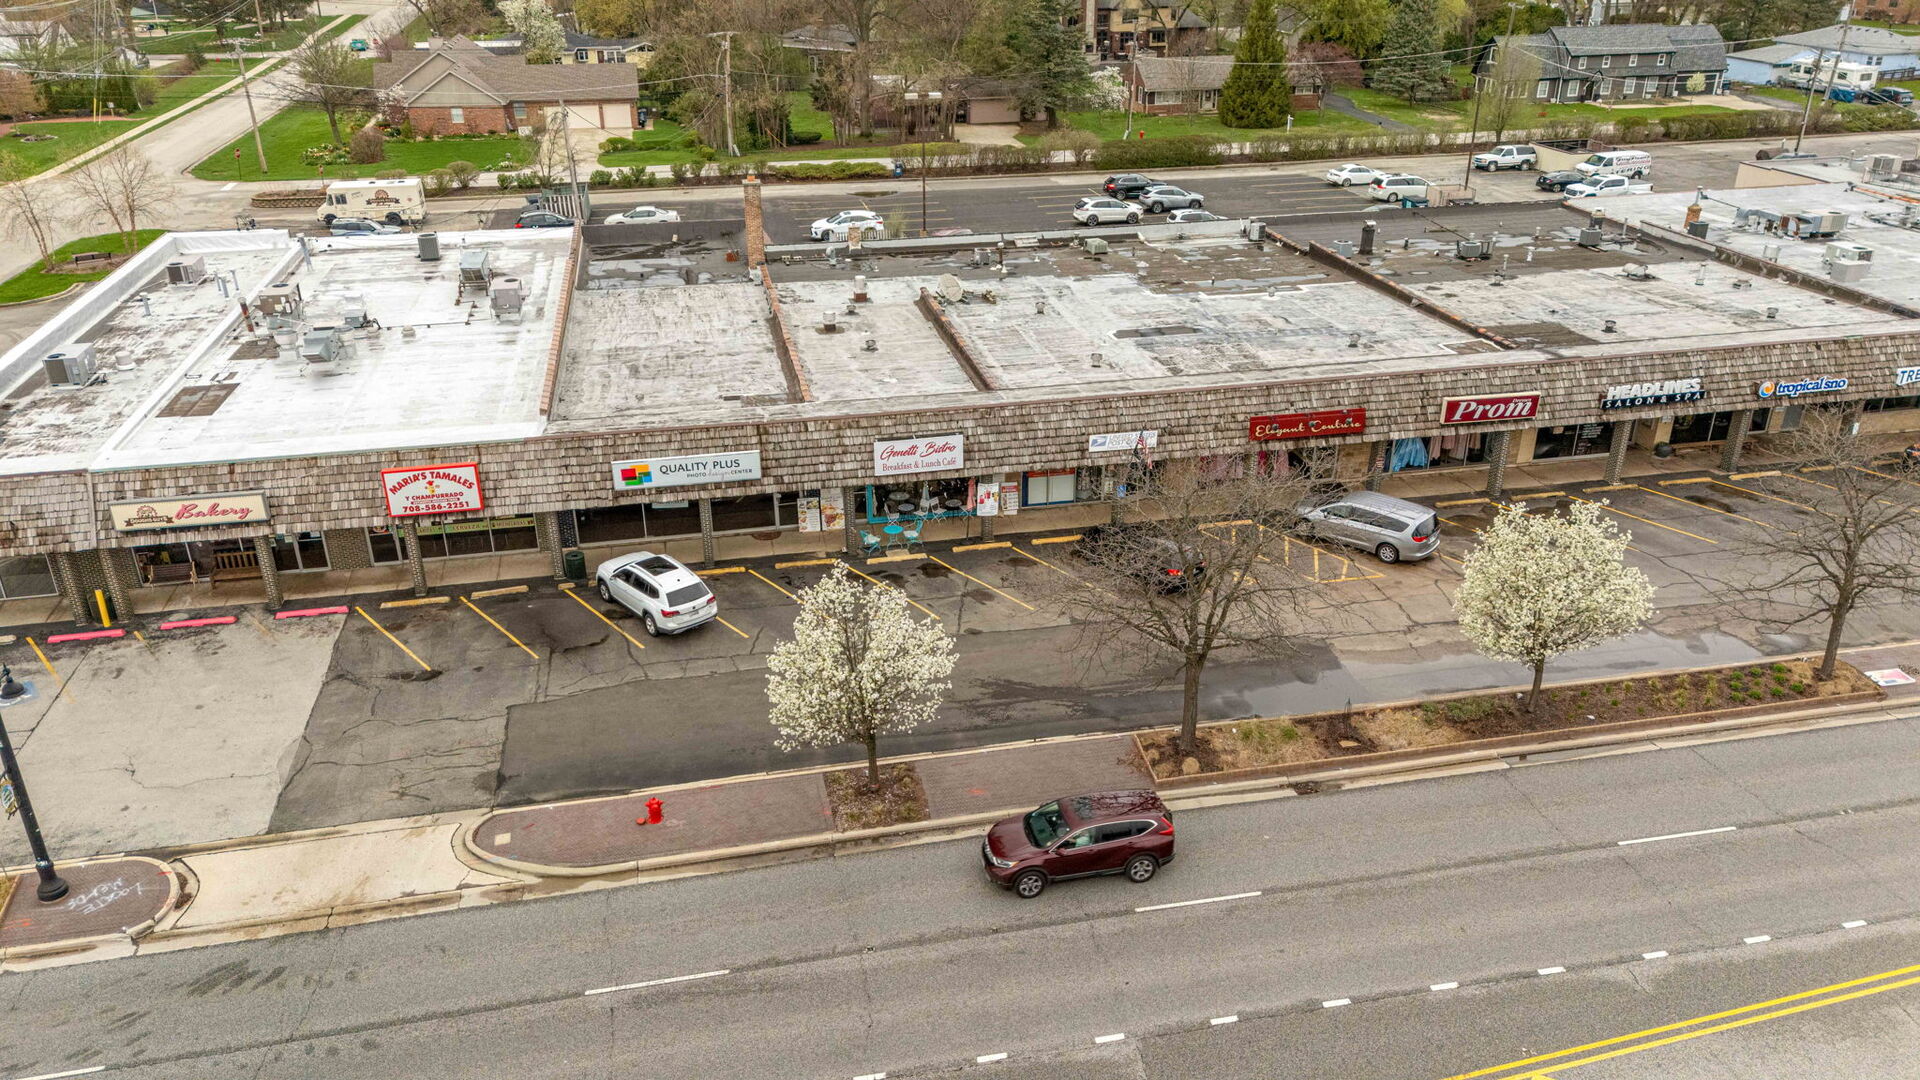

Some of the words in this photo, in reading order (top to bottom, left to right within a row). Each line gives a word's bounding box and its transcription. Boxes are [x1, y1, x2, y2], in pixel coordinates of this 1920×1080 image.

[1606, 378, 1701, 400] HEADLINES
[1605, 396, 1654, 408] SALON
[1660, 395, 1667, 403] &
[1675, 391, 1701, 401] SPA
[1450, 400, 1533, 421] Prom
[879, 444, 919, 461] Genetti
[920, 441, 957, 458] Bistro
[659, 461, 709, 475] QUALITY
[712, 459, 741, 470] PLUS
[882, 461, 913, 471] Breakfast
[913, 461, 919, 469] &
[921, 459, 941, 468] Lunch
[942, 457, 957, 466] Café
[389, 471, 427, 495] MARIA'S
[429, 471, 475, 490] TAMALES
[411, 491, 464, 501] CHAMPURRADO
[174, 502, 253, 520] Bakery
[402, 501, 470, 512] 708-586-2251
